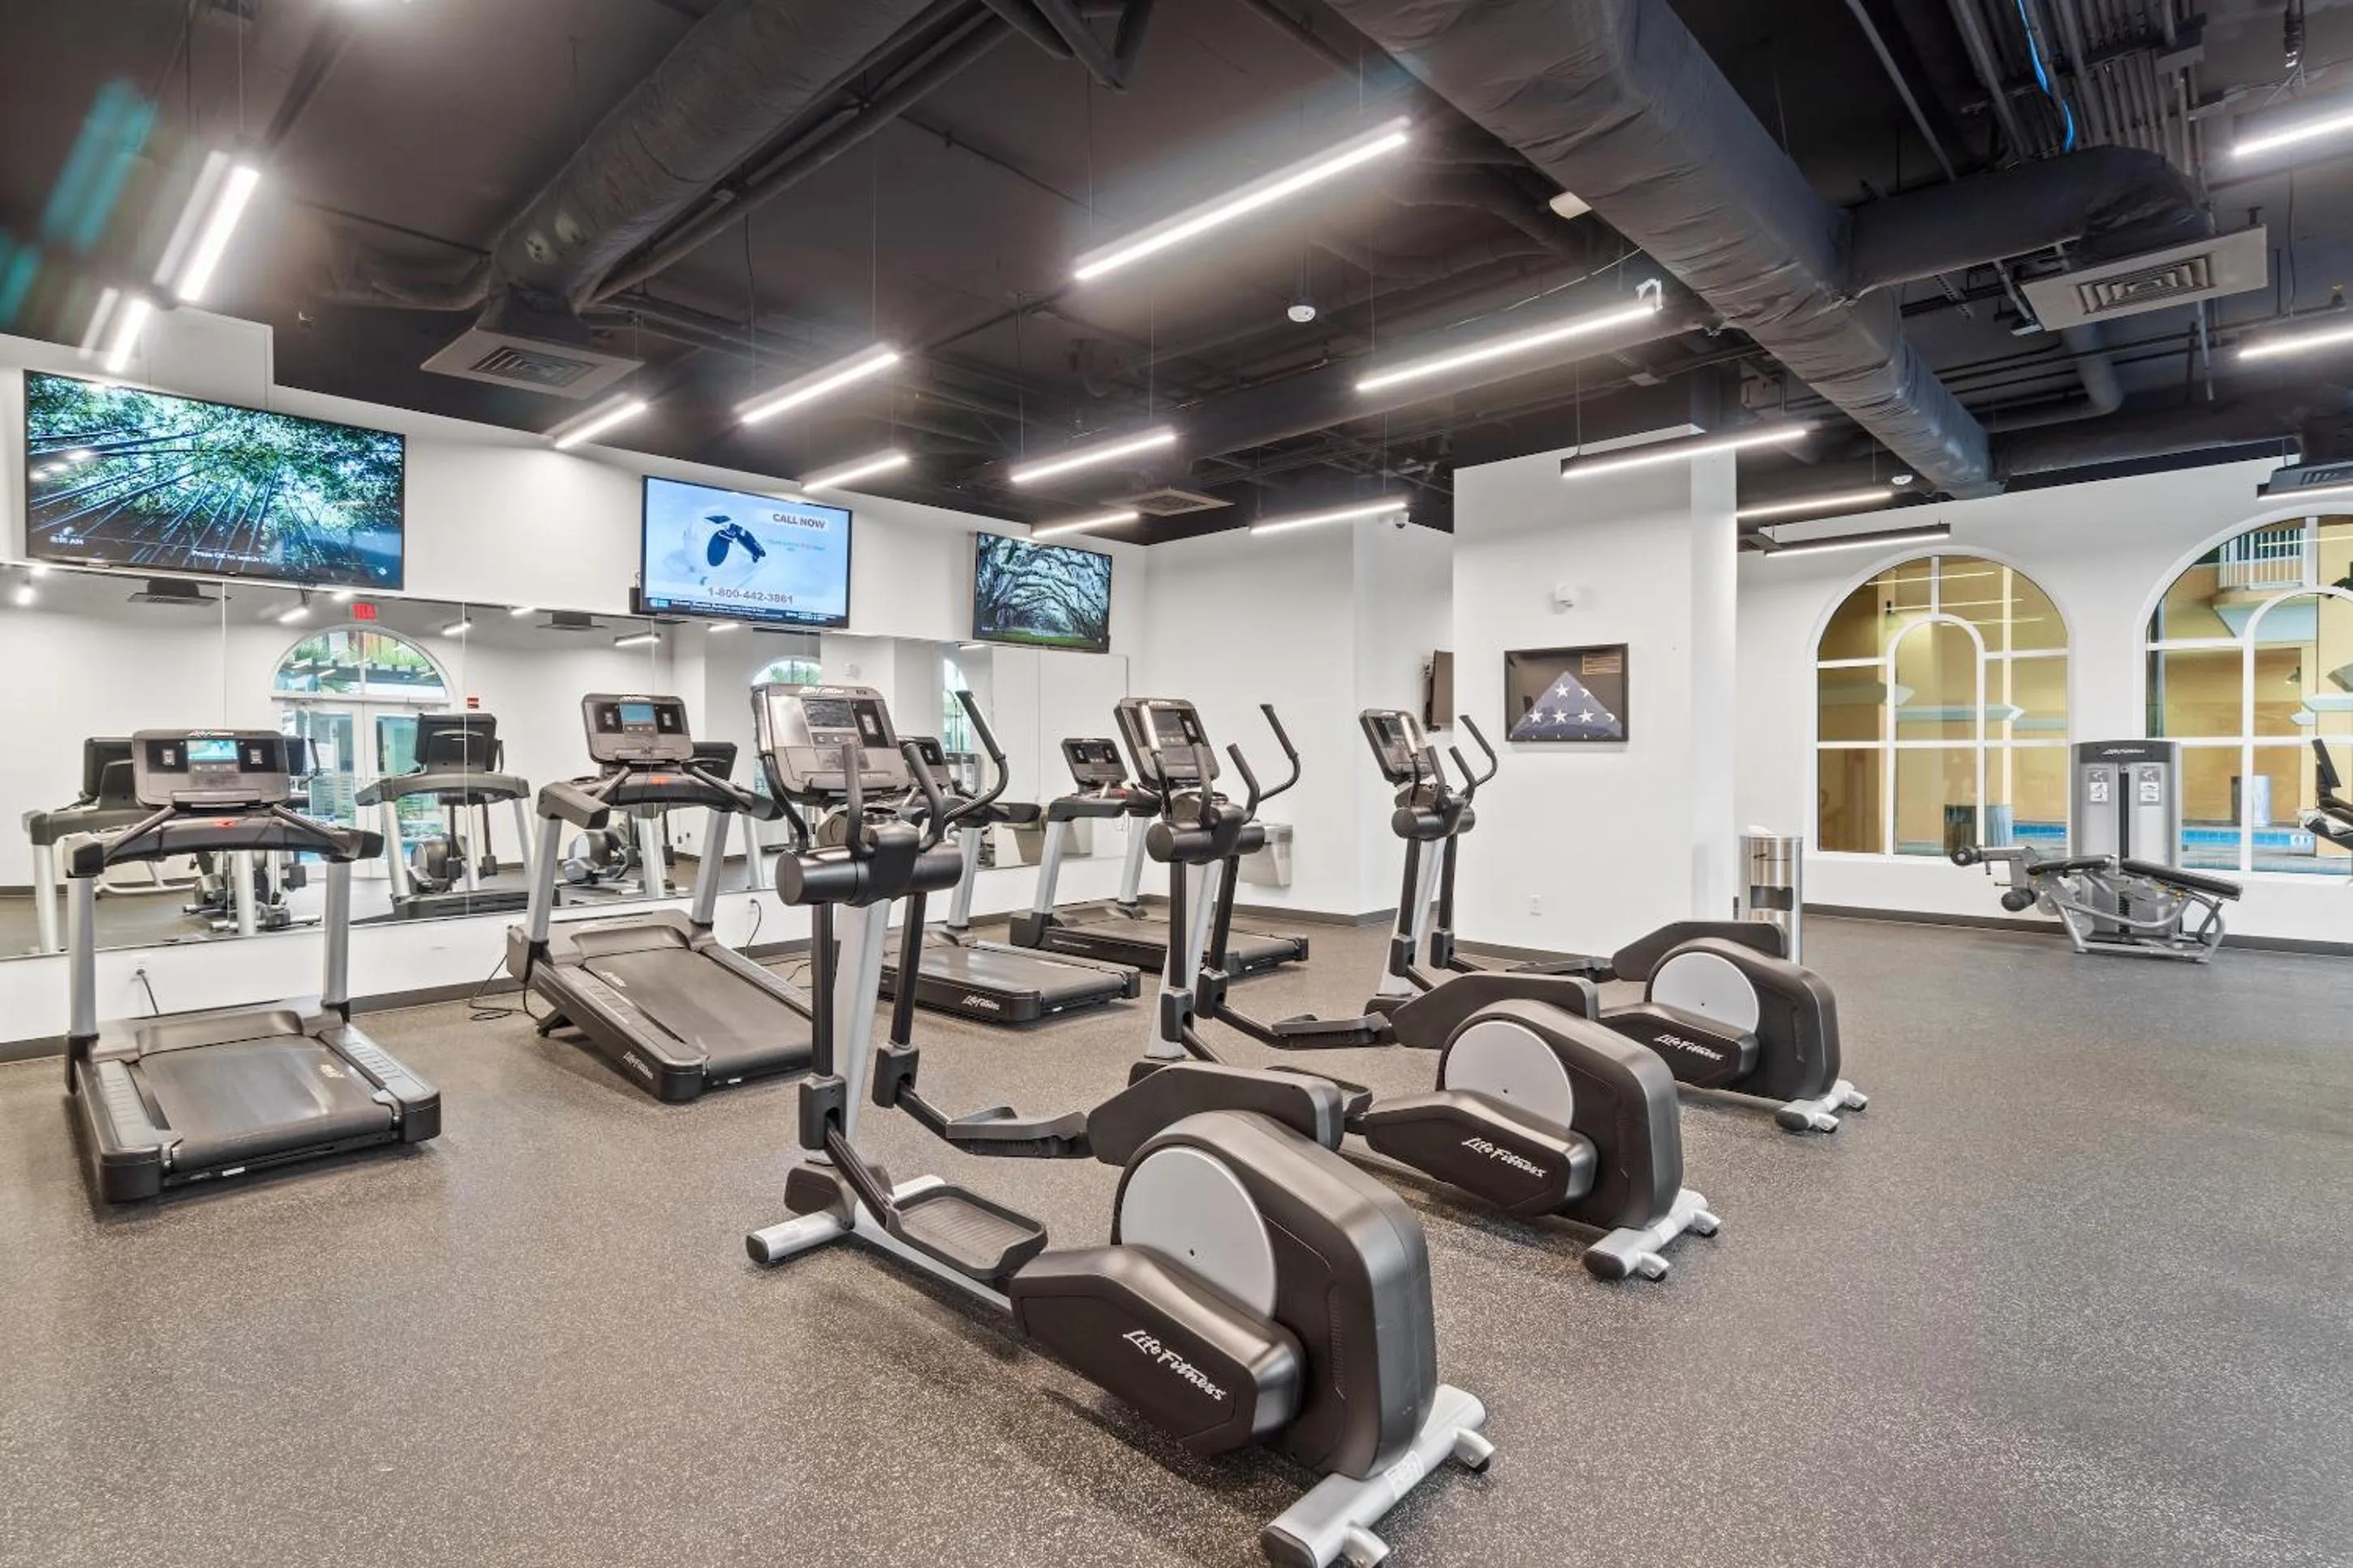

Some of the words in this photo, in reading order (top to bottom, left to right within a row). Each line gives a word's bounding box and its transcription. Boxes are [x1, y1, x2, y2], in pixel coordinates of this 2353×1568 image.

[772, 513, 798, 525] CALL
[799, 518, 826, 530] NOW
[1654, 1034, 1681, 1046] Life
[1677, 1041, 1724, 1061] Fitness
[1461, 1137, 1494, 1153] Life
[1490, 1147, 1547, 1179] Fitness
[1122, 1330, 1162, 1355] Life
[1157, 1348, 1228, 1401] Fitness
